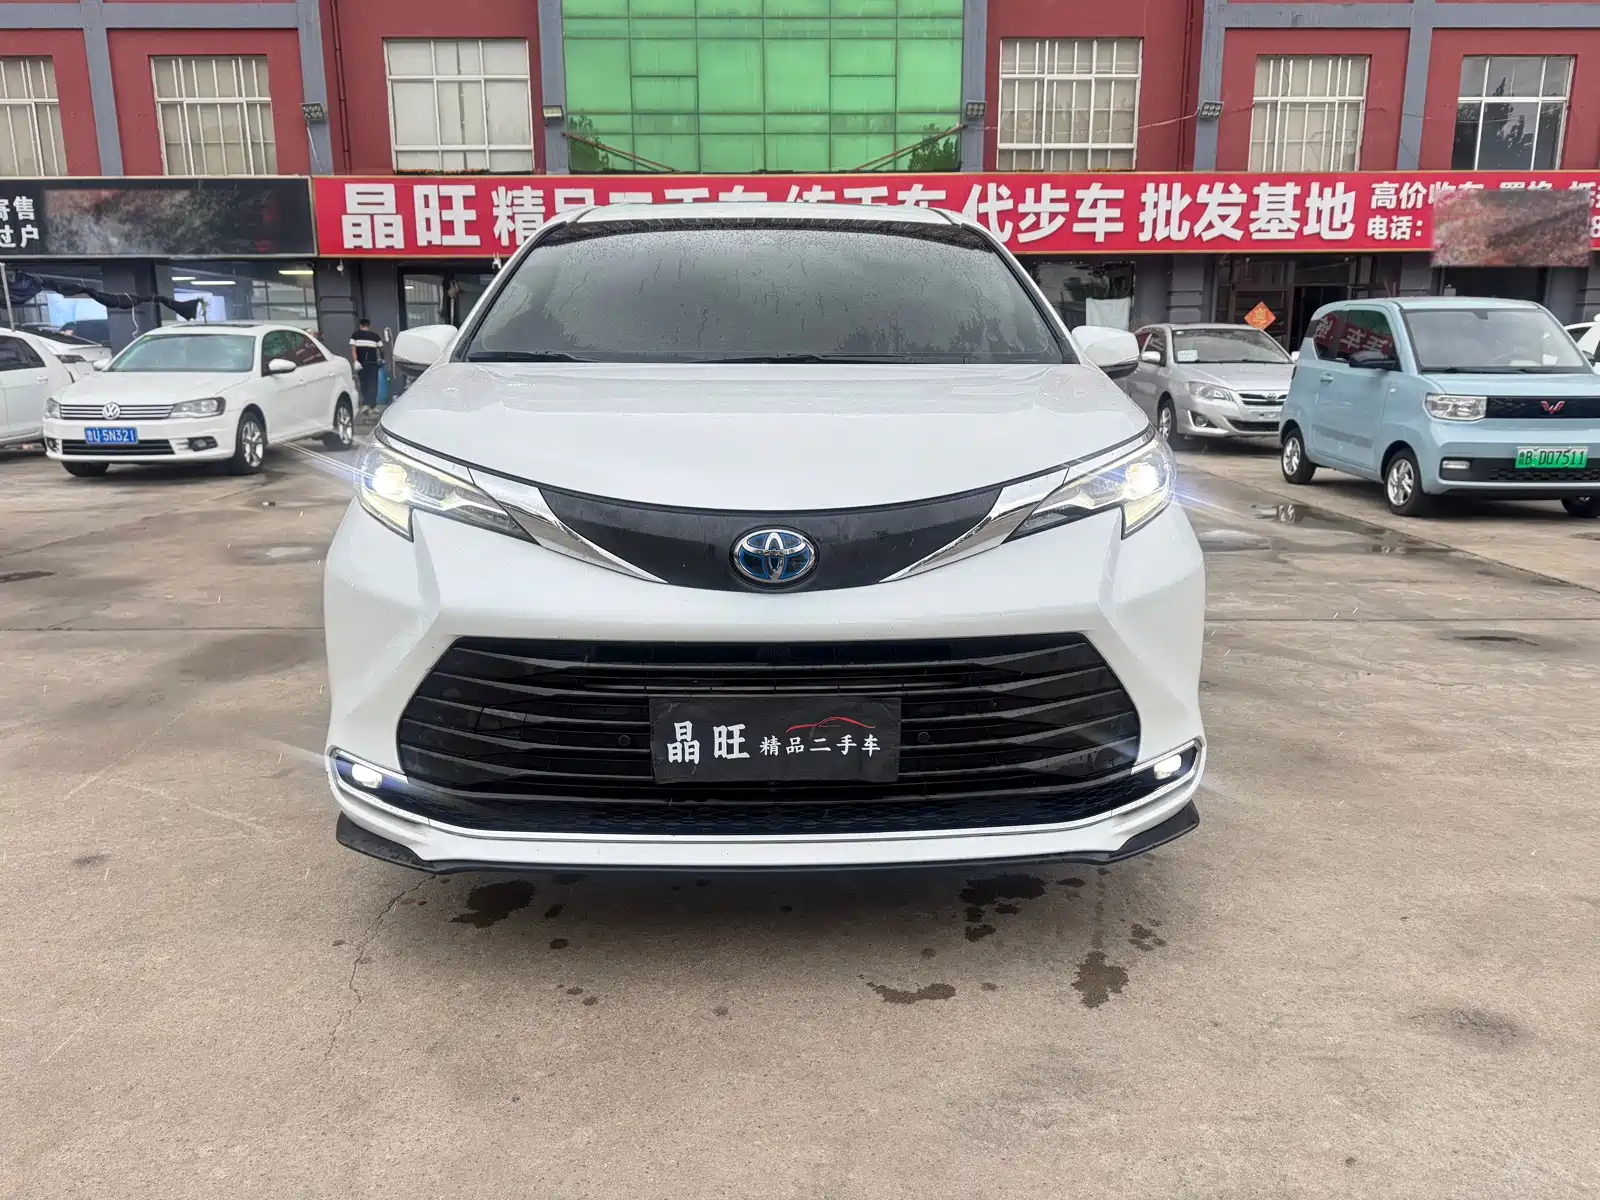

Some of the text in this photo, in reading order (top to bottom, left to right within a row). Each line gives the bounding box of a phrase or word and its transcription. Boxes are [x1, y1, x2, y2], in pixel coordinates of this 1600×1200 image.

[341, 183, 481, 249] 晶旺
[962, 182, 1124, 243] 代步车
[1139, 182, 1356, 243] 批发基地
[666, 720, 881, 764] 晶旺 精品二手车
